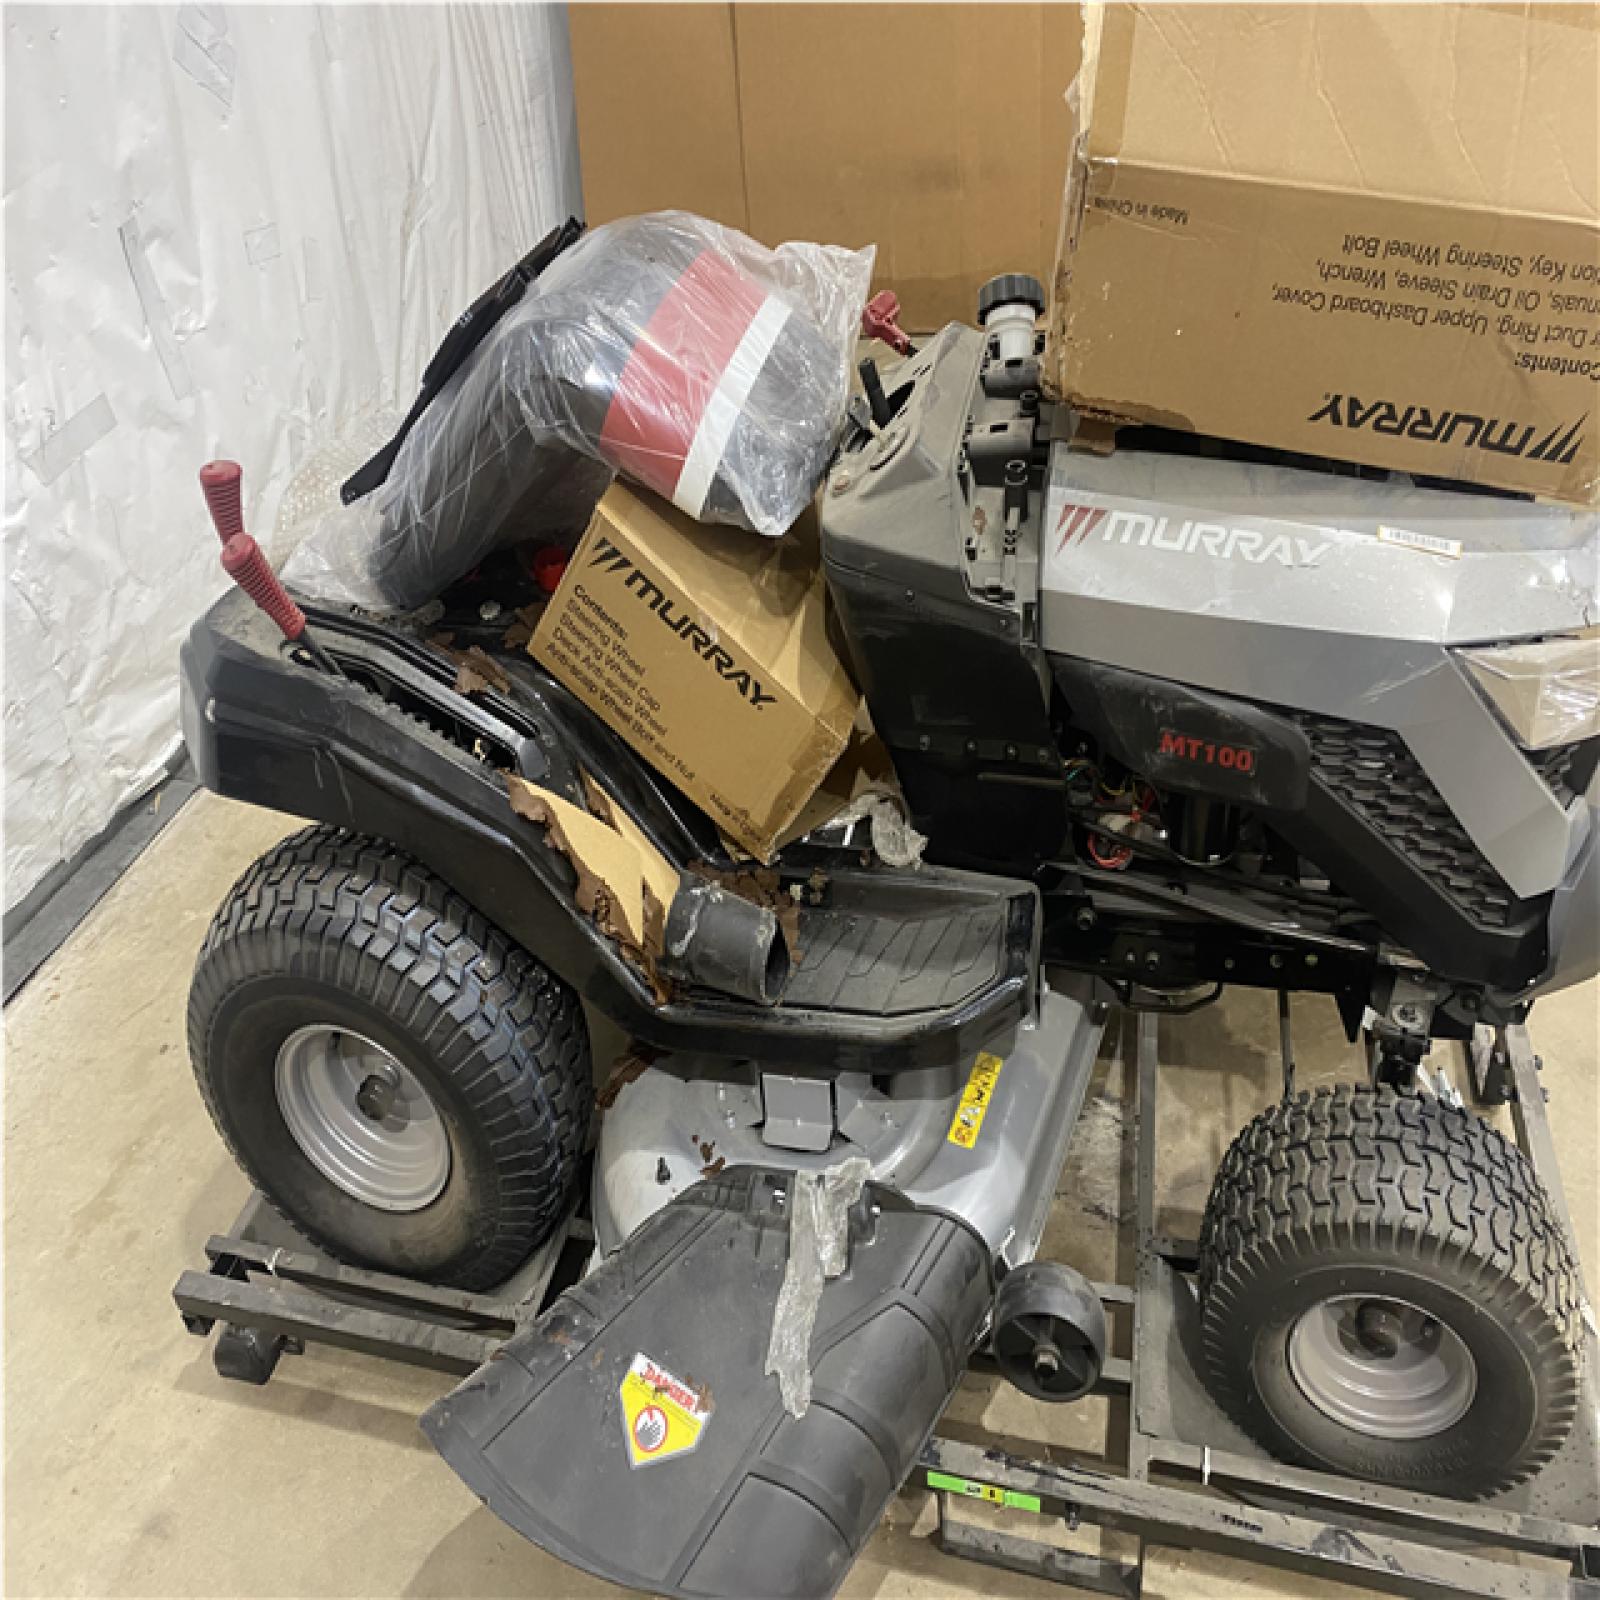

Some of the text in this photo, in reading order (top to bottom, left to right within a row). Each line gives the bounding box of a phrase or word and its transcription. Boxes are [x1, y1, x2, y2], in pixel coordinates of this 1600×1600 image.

[1094, 196, 1191, 225] Made in China
[1342, 234, 1381, 258] Bolt
[1382, 239, 1441, 266] Wheel
[1445, 243, 1523, 278] Steering
[1317, 258, 1386, 290] Wrench,
[1395, 269, 1458, 300] Sleeve,
[1272, 283, 1325, 311] Cover,
[1330, 294, 1428, 326] Dashboard
[1463, 282, 1511, 308] Drain
[1515, 289, 1541, 311] Oil
[1431, 309, 1488, 335] Upper
[1544, 328, 1588, 348] Duct
[1307, 393, 1536, 456] MURRAY
[1102, 510, 1333, 566] MURRAY
[574, 584, 628, 640] Contents:
[566, 598, 645, 677] Steering Wheel
[624, 569, 778, 705] MURRAY
[560, 612, 661, 712] Steering Wheel Cap
[552, 626, 581, 658] Deck
[635, 701, 667, 736] Wheel
[600, 688, 633, 725] Wheel
[655, 743, 676, 763] and
[1159, 730, 1253, 772] MT100
